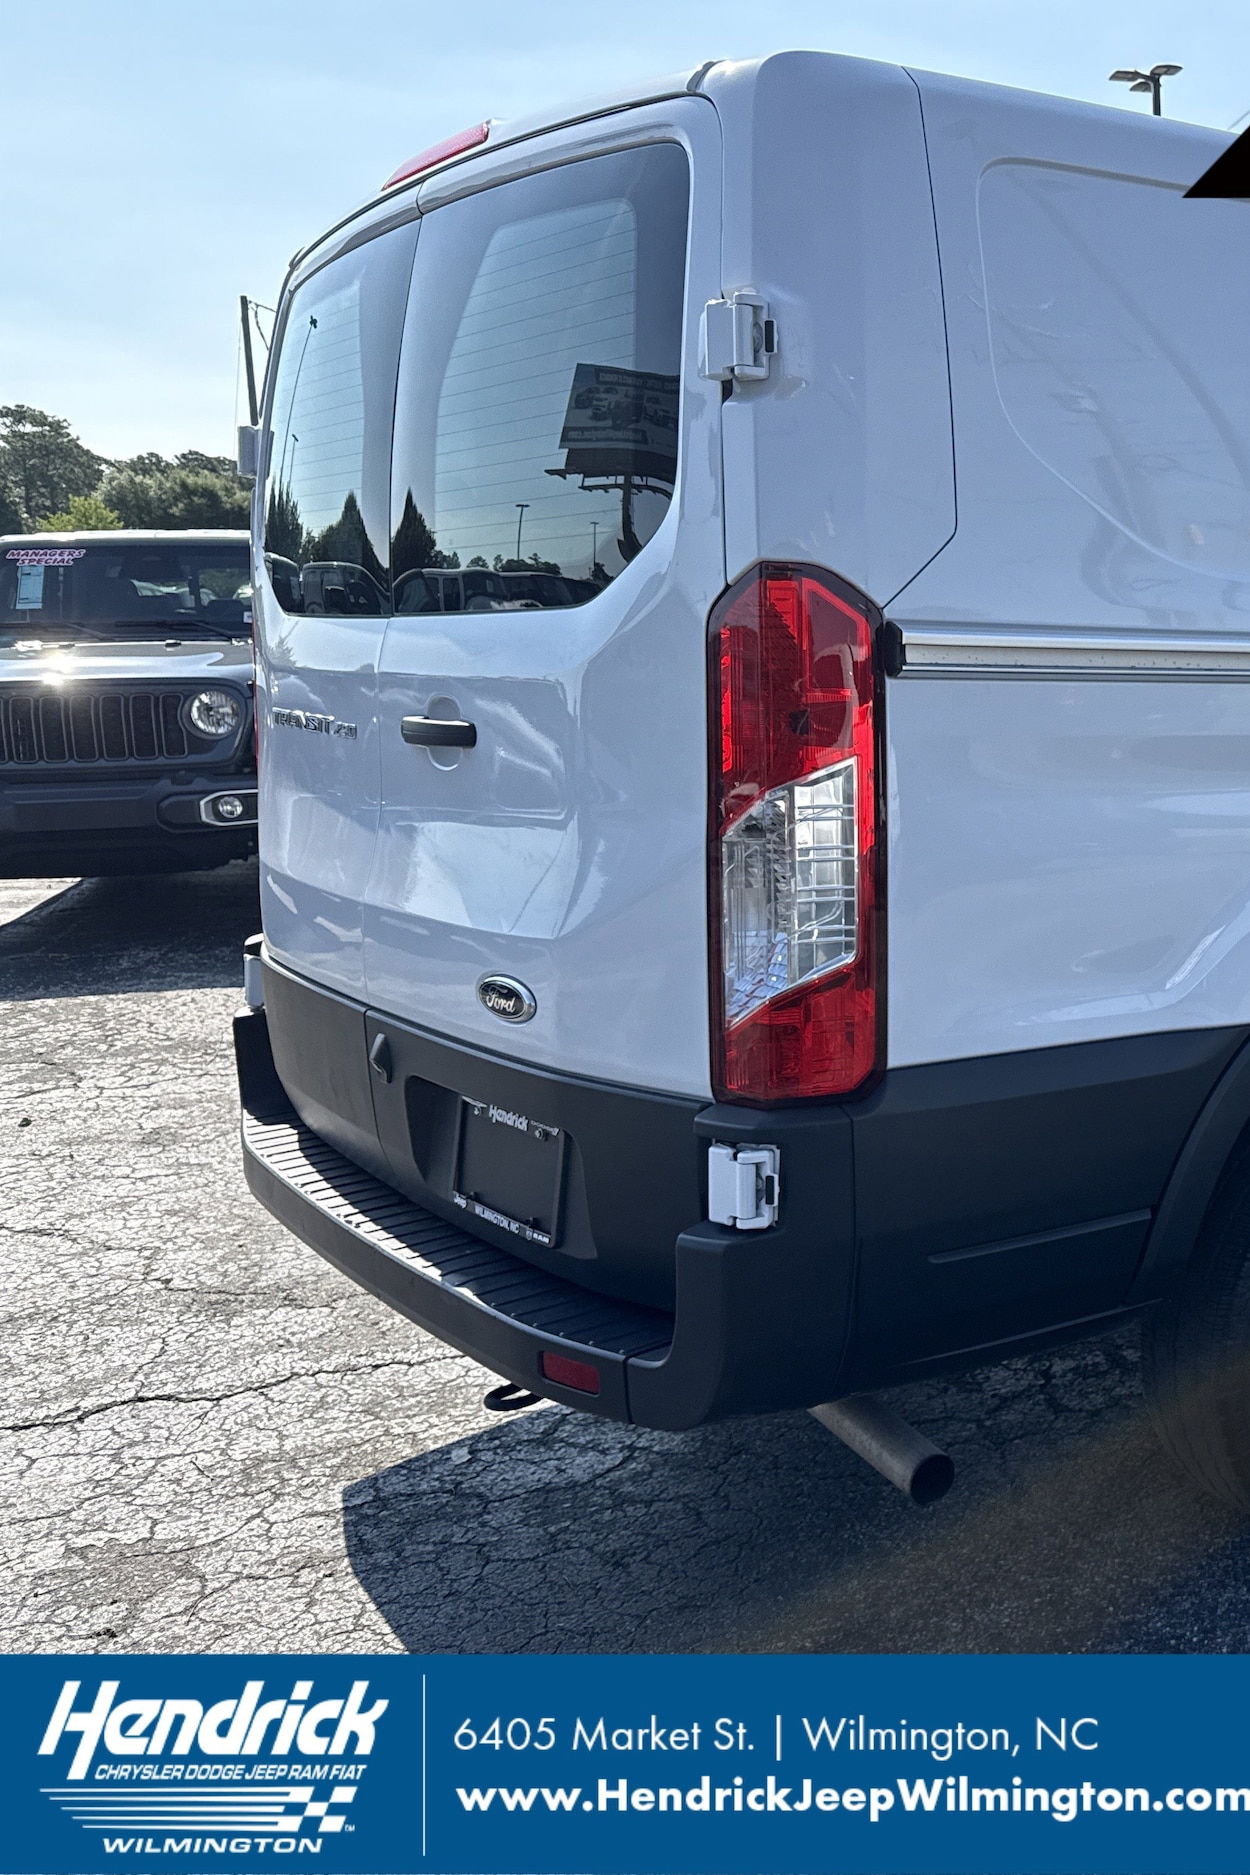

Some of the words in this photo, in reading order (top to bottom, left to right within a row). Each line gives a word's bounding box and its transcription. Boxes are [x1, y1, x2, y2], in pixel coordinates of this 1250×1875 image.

[6, 549, 86, 559] MANAGERS
[17, 557, 74, 566] SPECIAL
[486, 986, 516, 1013] Ford
[488, 1104, 529, 1132] Hendrick
[532, 1233, 550, 1244] RAM
